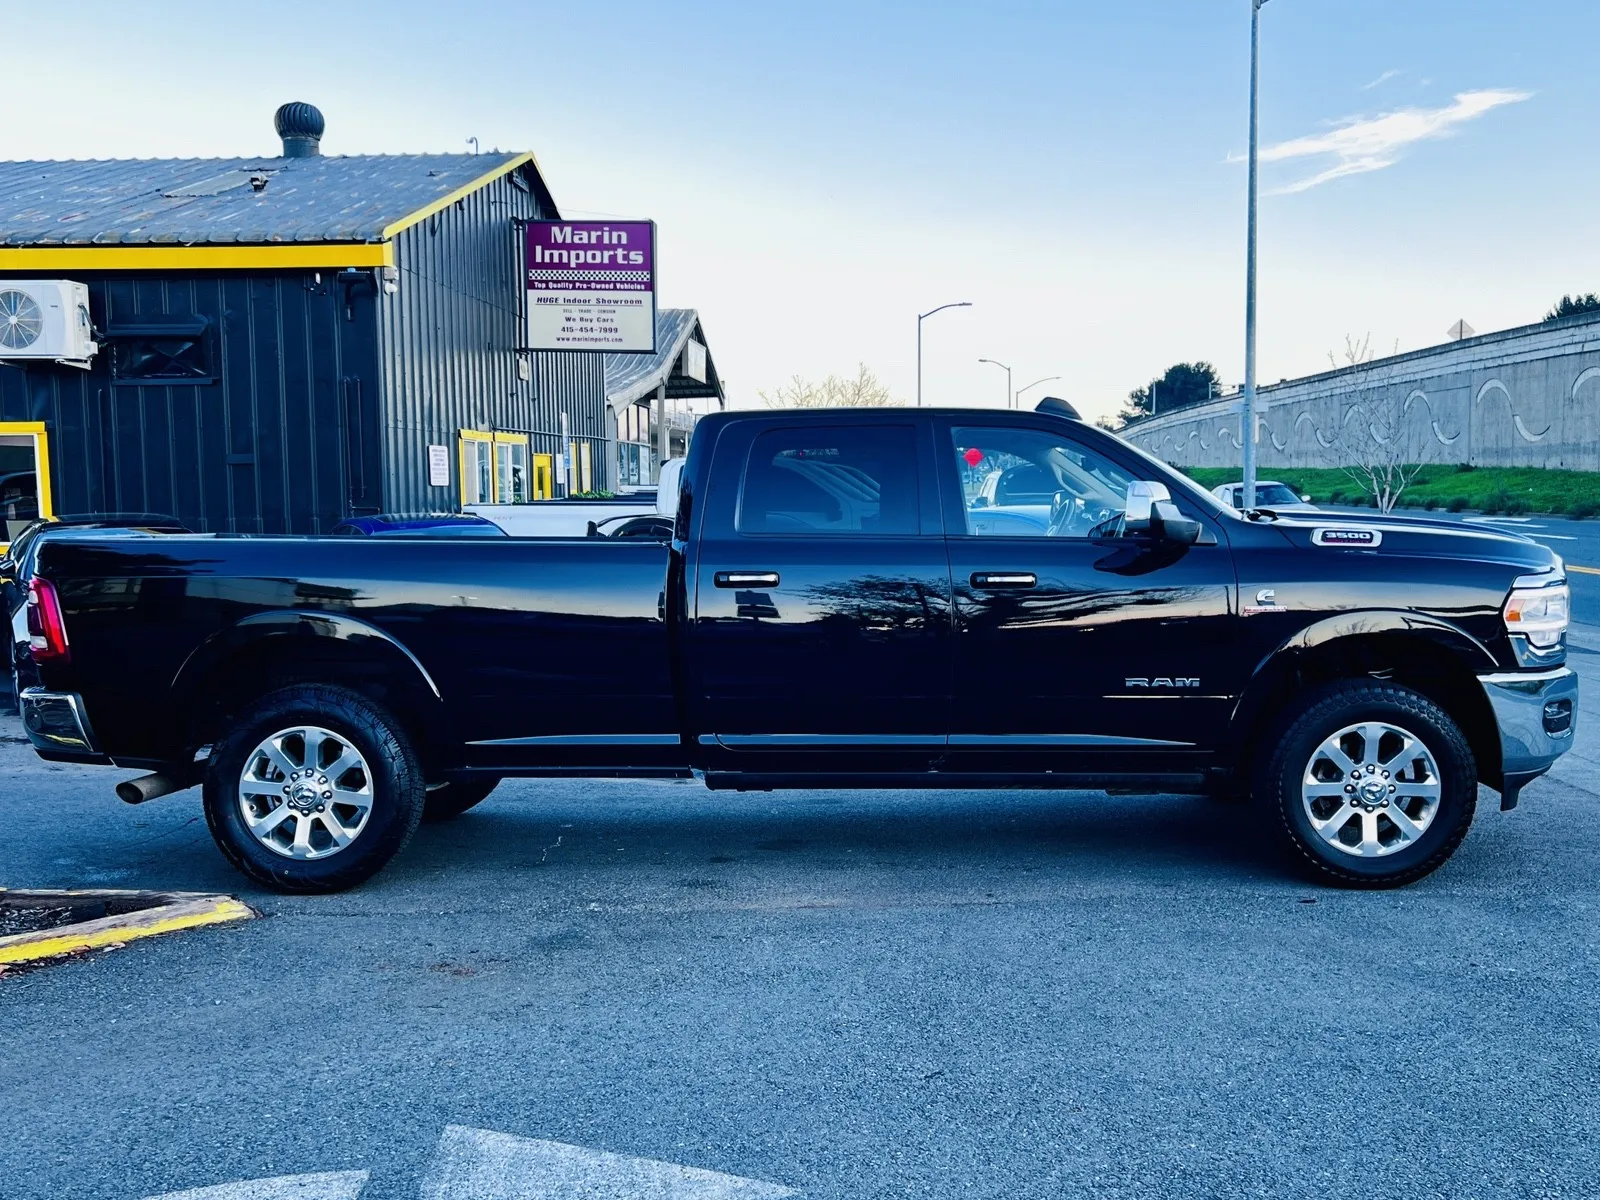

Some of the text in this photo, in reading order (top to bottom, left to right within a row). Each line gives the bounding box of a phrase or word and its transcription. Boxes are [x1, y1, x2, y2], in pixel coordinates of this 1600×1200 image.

[551, 226, 628, 244] Marin
[535, 245, 644, 268] Imports
[549, 282, 573, 290] Quality
[575, 282, 614, 290] Pre-Owned
[1125, 677, 1200, 687] RAM
